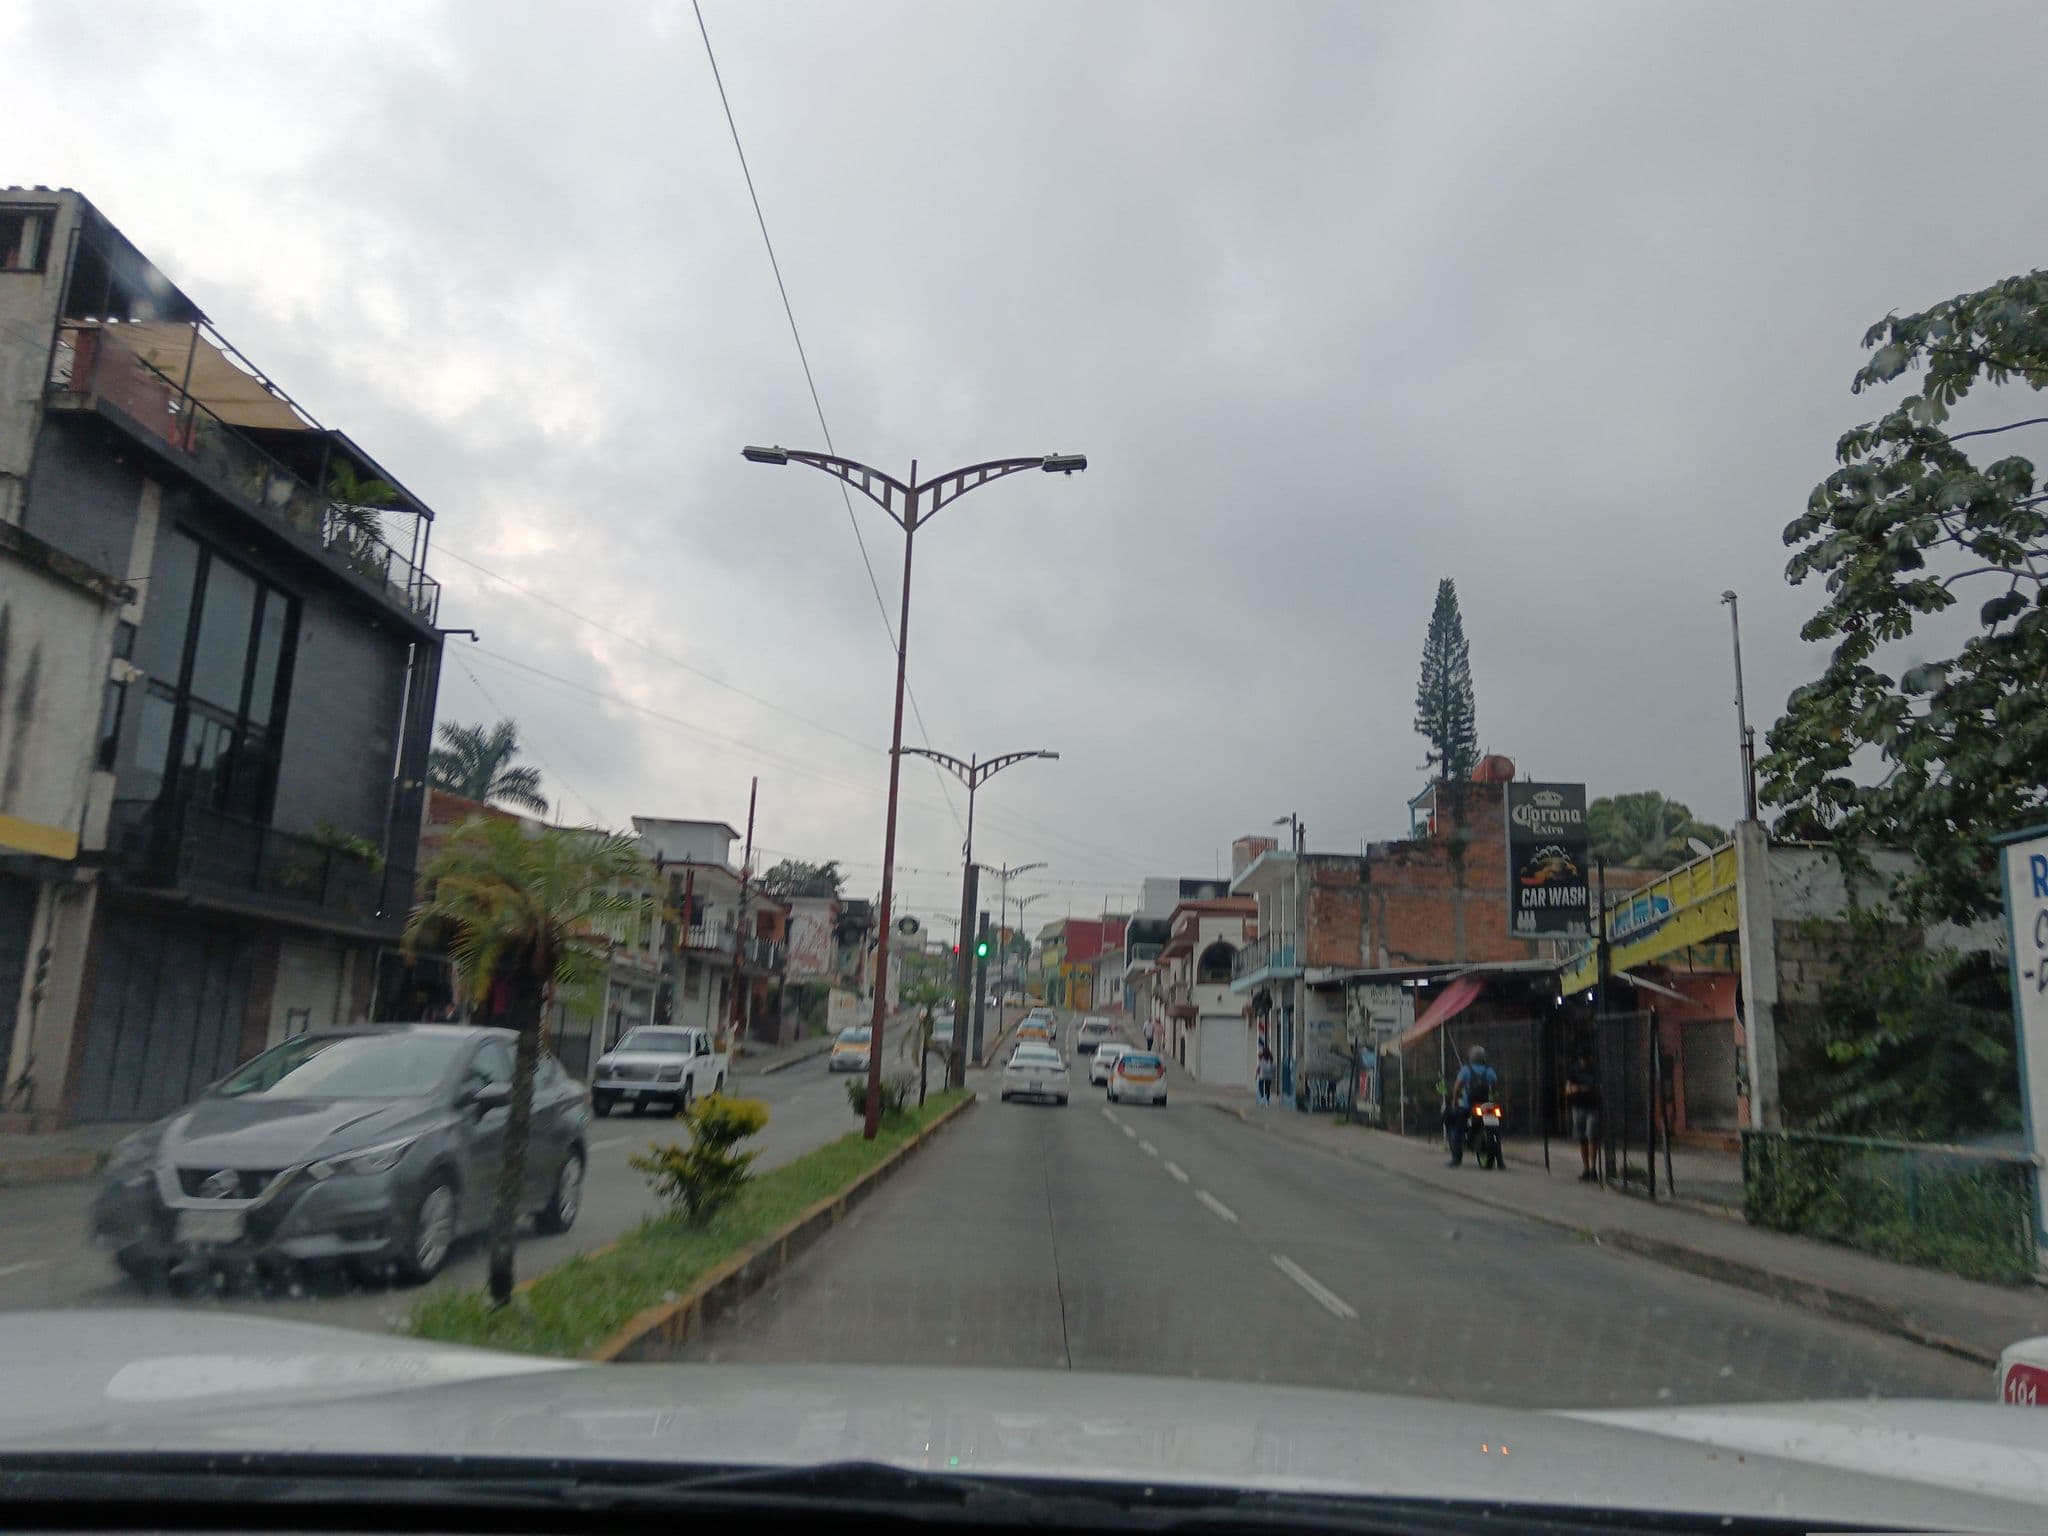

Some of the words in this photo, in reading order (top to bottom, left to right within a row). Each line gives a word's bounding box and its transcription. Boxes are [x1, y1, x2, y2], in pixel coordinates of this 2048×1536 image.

[1512, 803, 1581, 829] Corona
[1532, 823, 1564, 835] Extra
[1521, 888, 1547, 907] CAR
[1548, 886, 1587, 907] WASH
